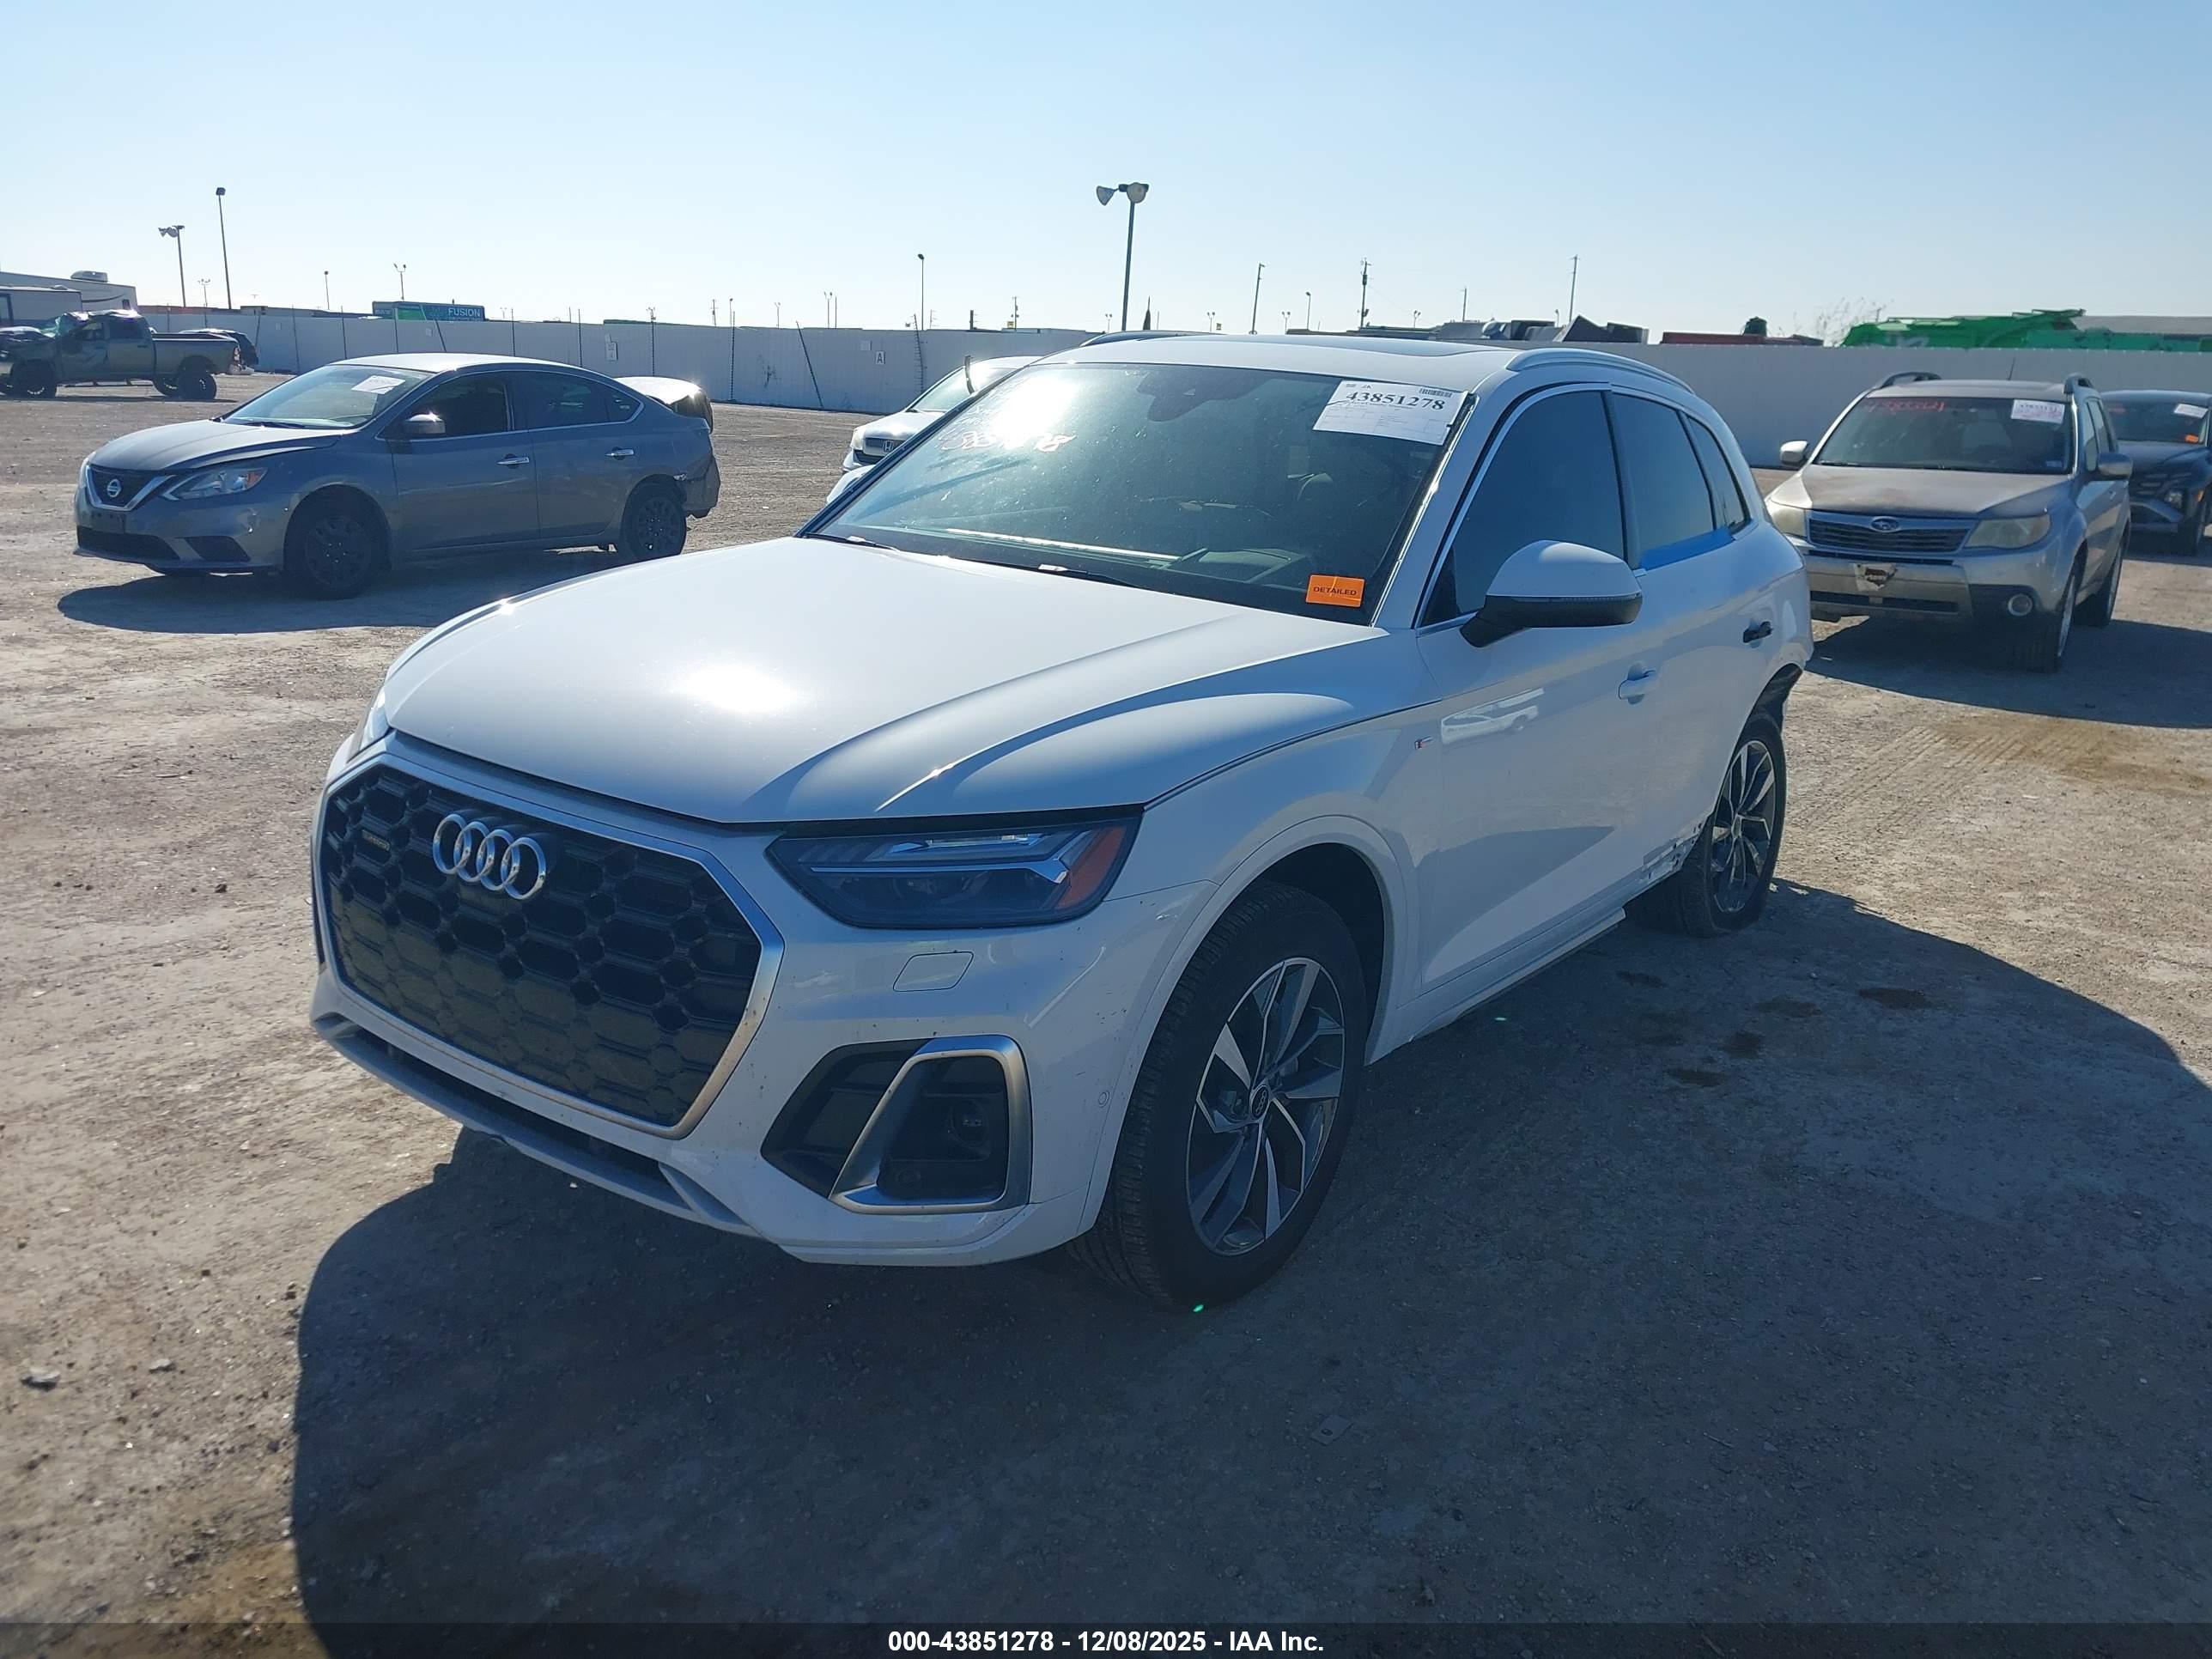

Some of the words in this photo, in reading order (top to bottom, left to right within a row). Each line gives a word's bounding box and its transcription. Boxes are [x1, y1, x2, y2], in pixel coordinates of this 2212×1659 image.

[448, 307, 481, 317] FUSION
[876, 352, 884, 364] A
[1346, 391, 1446, 410] 43851278
[1312, 586, 1358, 597] DETAILED
